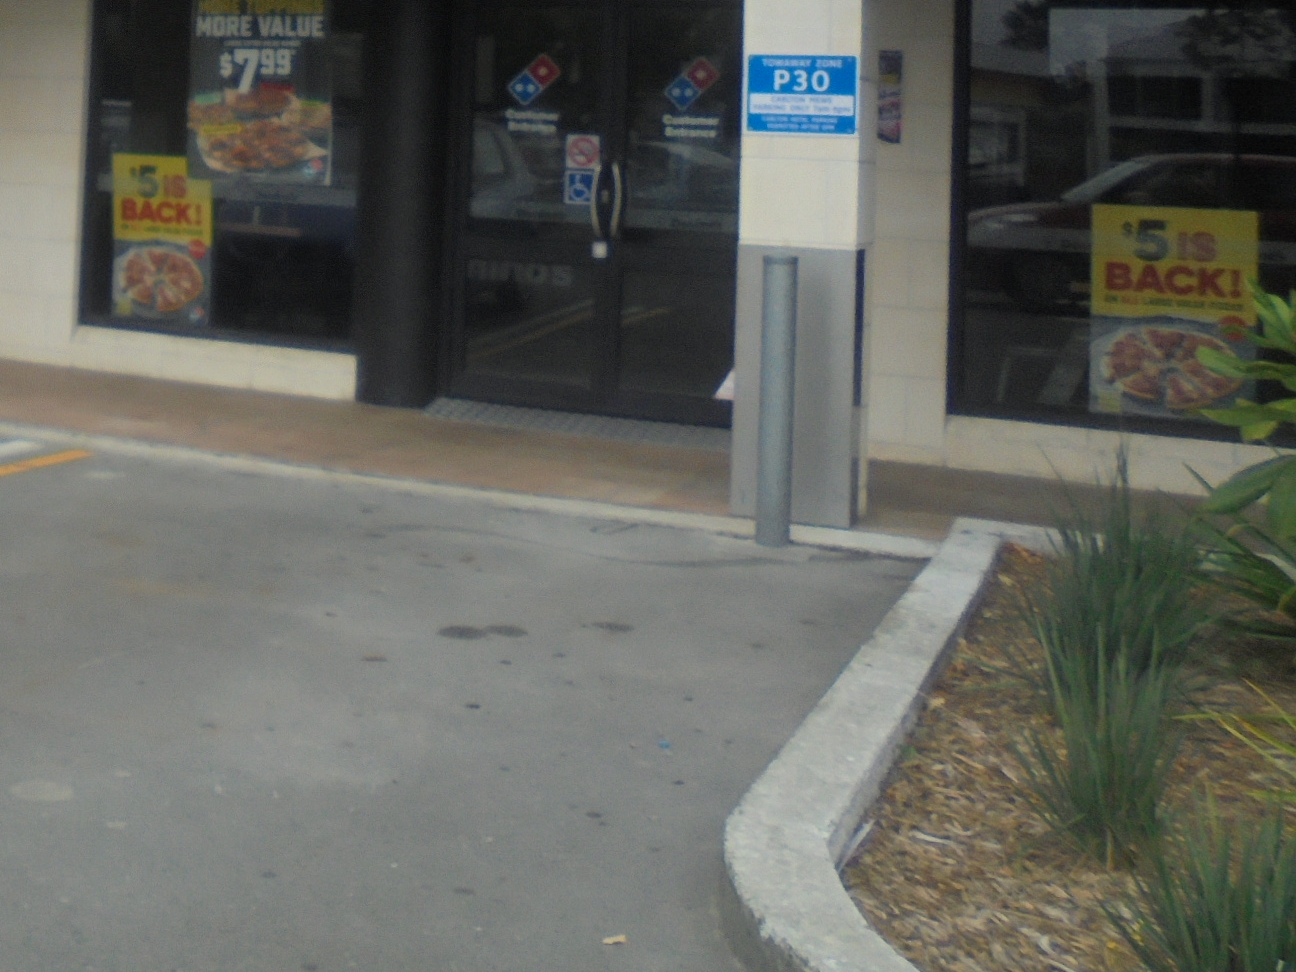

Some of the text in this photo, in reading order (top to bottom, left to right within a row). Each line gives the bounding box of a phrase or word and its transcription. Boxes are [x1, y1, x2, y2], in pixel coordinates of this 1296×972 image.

[196, 15, 324, 37] MORE VALUE
[772, 69, 831, 92] P30
[163, 174, 187, 199] IS
[122, 197, 202, 226] BACK!
[1122, 219, 1217, 263] $5 IS
[1106, 261, 1242, 299] BACK!
